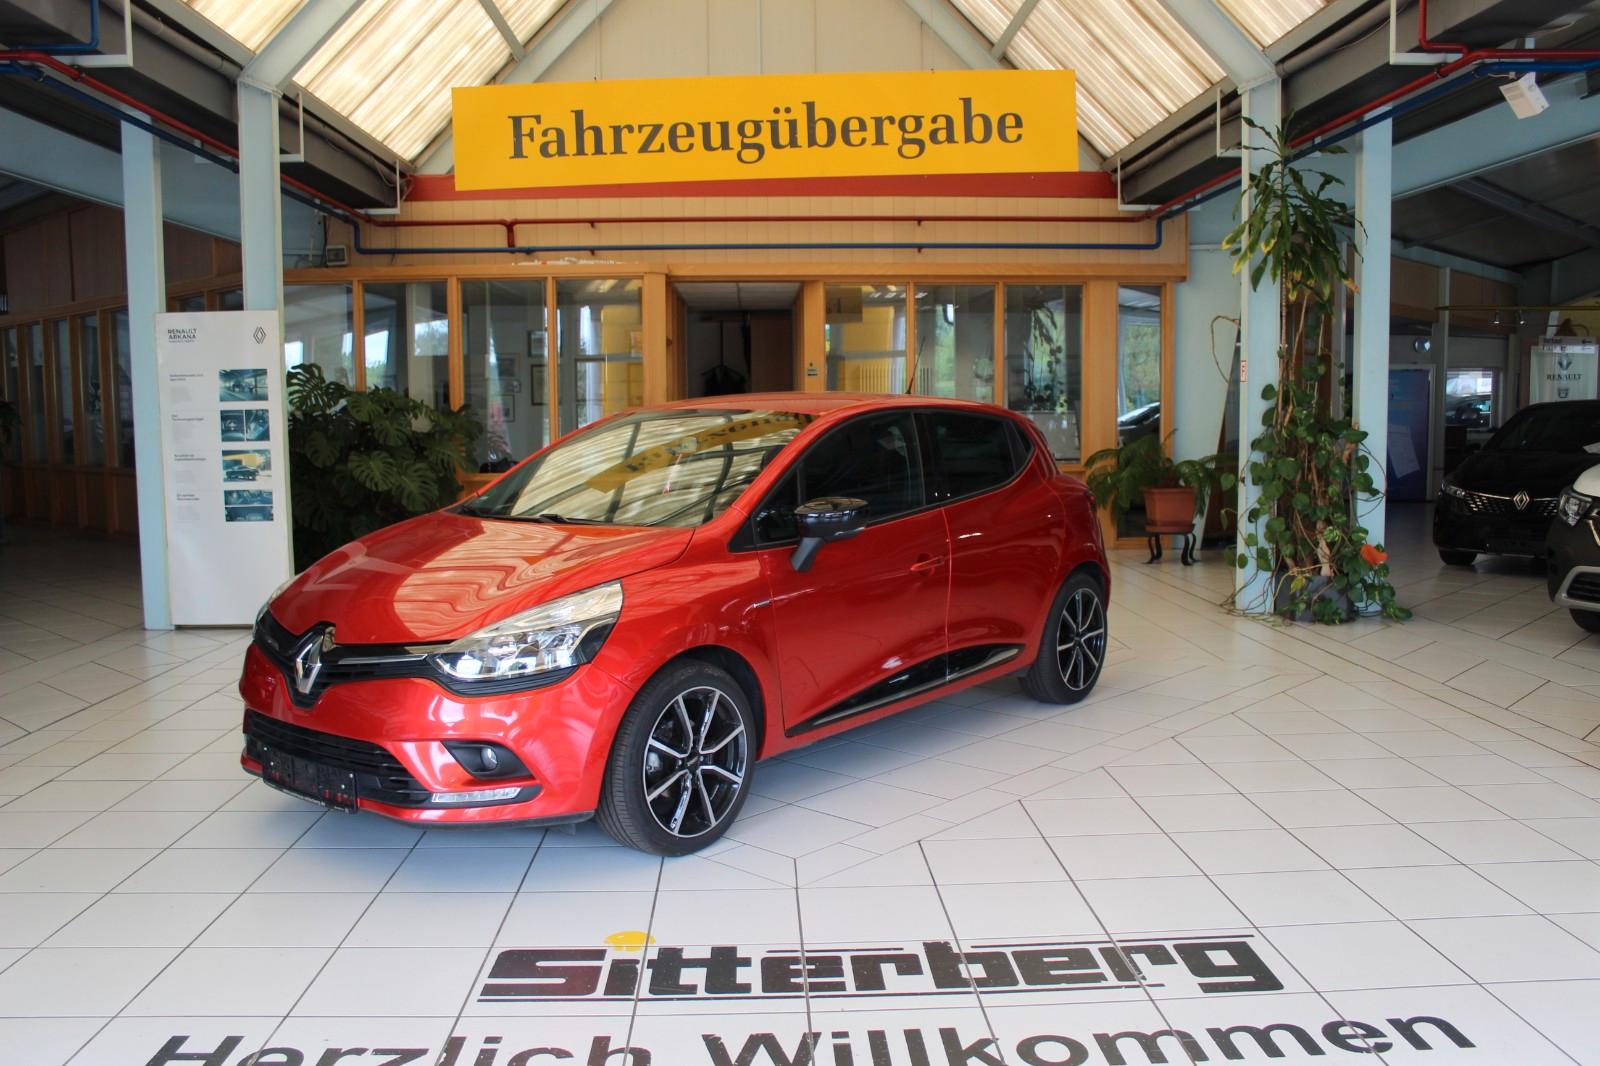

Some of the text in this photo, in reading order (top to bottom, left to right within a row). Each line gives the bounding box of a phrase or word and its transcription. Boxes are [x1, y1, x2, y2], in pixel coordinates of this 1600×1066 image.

[507, 97, 1024, 165] Fahrzeugübergabe
[1546, 373, 1582, 381] RENAULT
[145, 1015, 1477, 1066] Herzlich Willkommen
